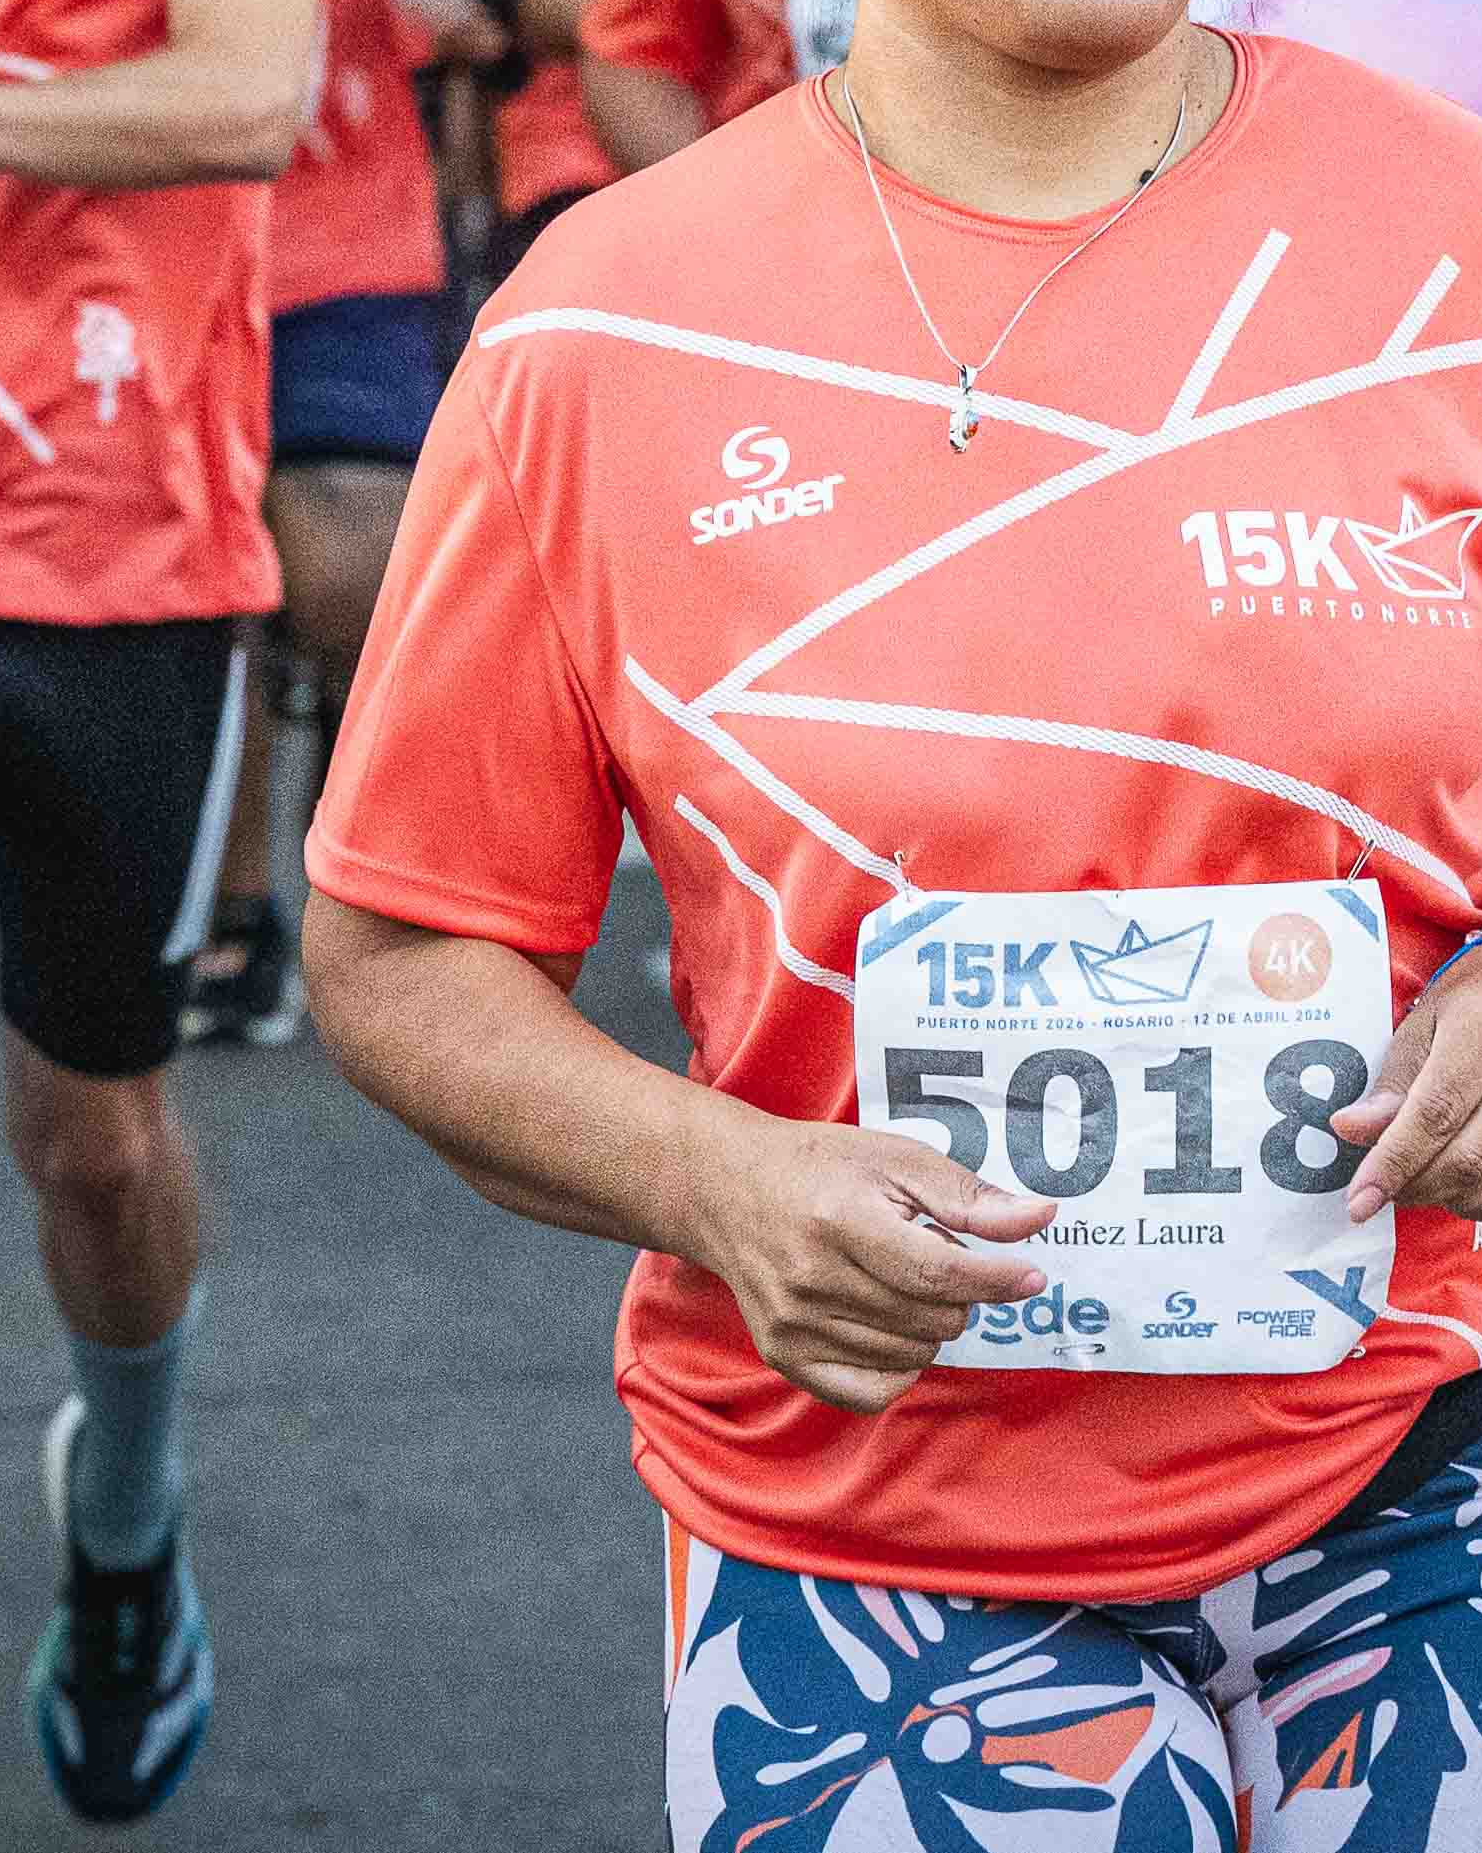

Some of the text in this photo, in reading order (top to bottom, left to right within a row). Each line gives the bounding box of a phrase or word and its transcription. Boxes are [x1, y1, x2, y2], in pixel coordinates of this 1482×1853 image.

[1180, 510, 1358, 591] 15K
[1211, 595, 1472, 629] PUERTO NORTE
[1262, 938, 1318, 974] 4K
[917, 941, 1059, 1008] 15K
[917, 1017, 979, 1030] PUERTO
[986, 1019, 1039, 1030] NORTE
[1046, 1018, 1085, 1030] 2026
[1103, 1015, 1174, 1028] ROSARIO
[1194, 1014, 1210, 1026] 12
[1217, 1012, 1236, 1025] DE
[1243, 1011, 1289, 1023] ABRIL
[1295, 1008, 1332, 1022] 2026
[884, 1039, 1369, 1198] 5018
[1135, 1217, 1225, 1246] Laura
[1237, 1308, 1316, 1325] POWER
